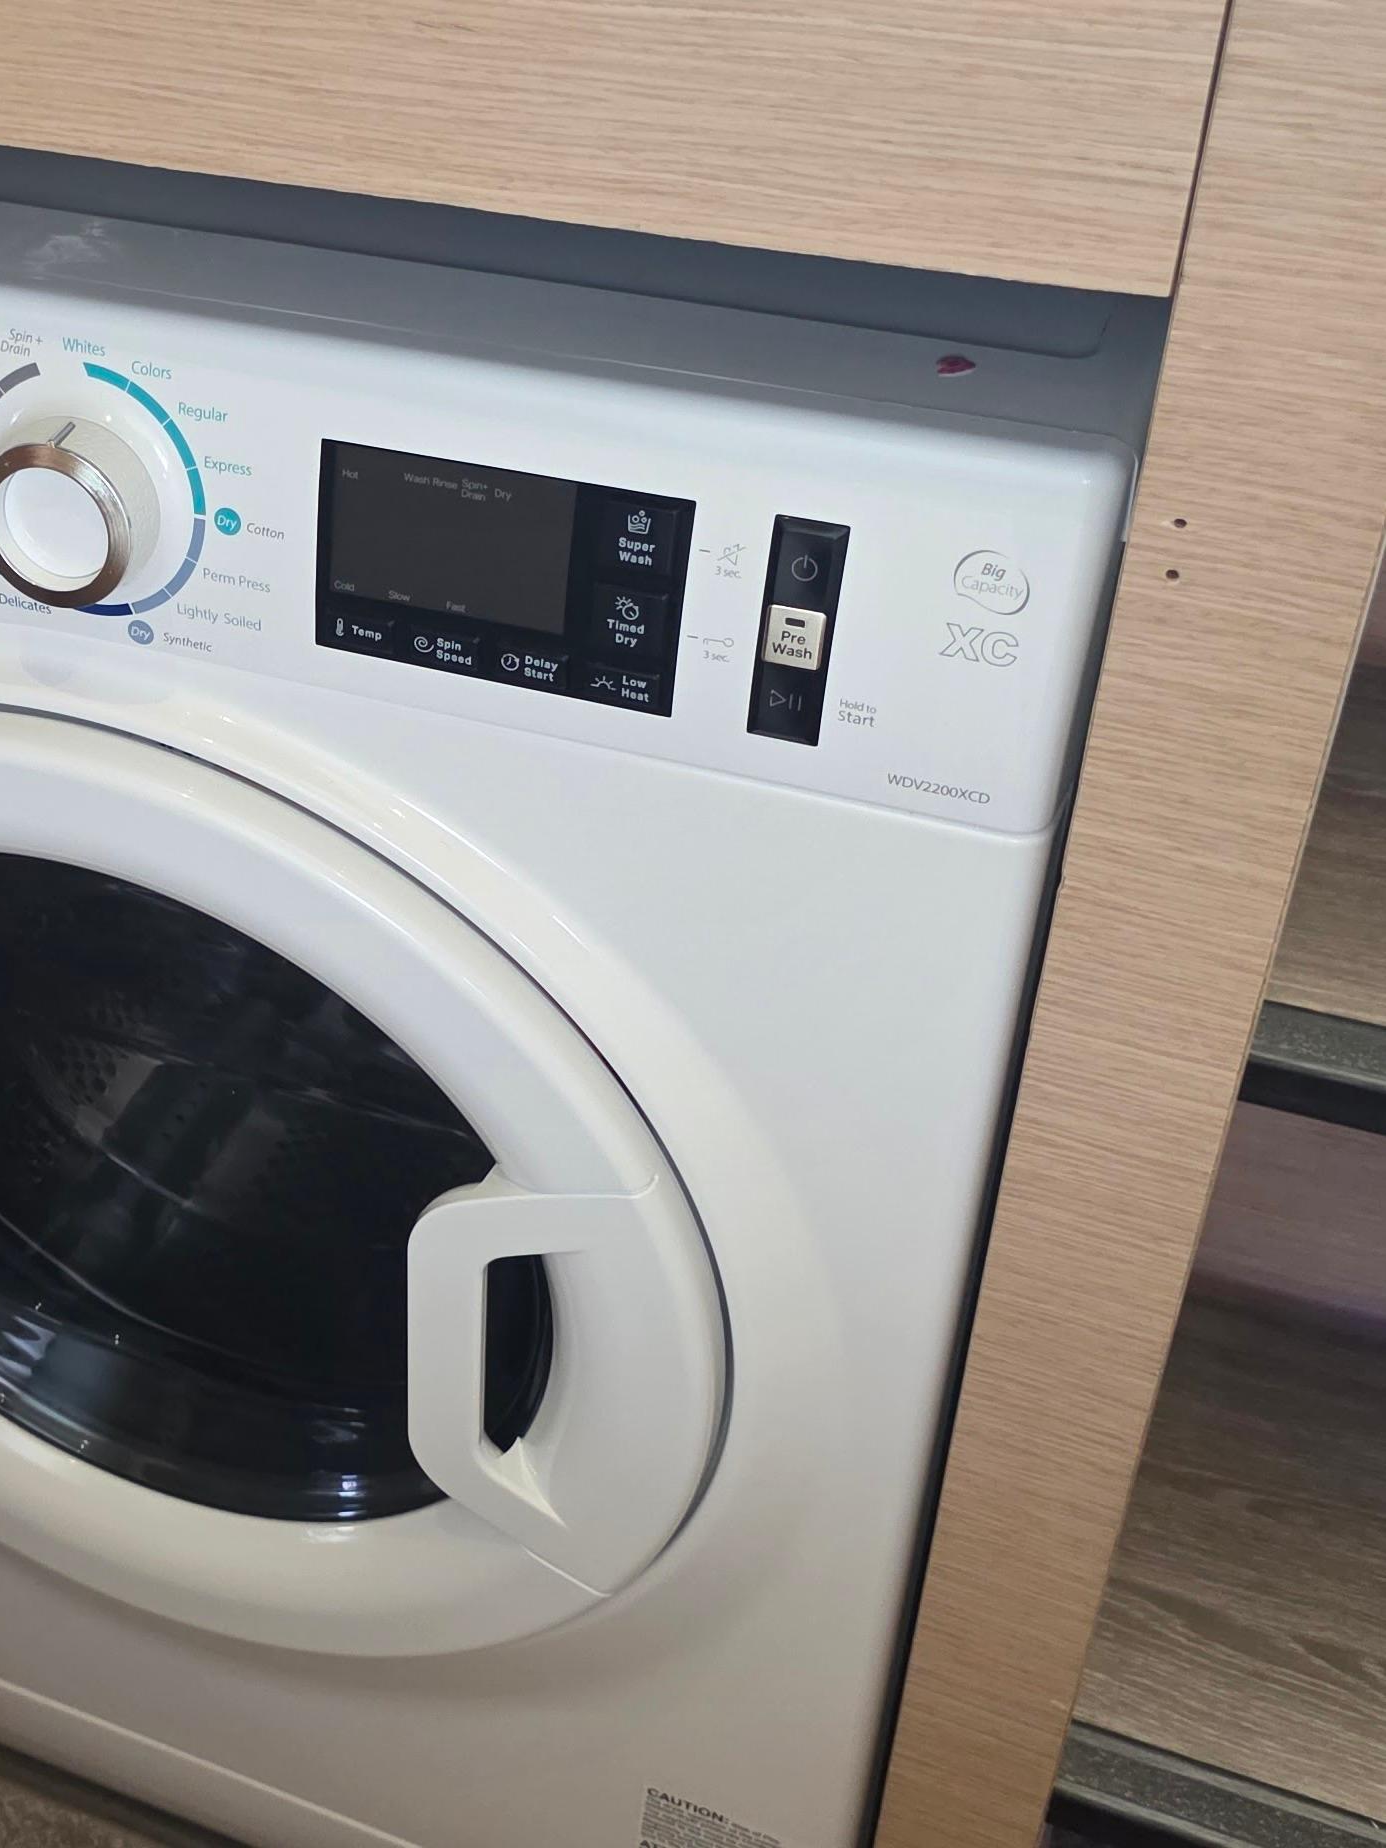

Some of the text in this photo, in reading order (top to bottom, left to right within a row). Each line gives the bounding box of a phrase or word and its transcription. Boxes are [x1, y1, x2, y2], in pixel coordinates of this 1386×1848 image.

[9, 328, 32, 346] Spin
[0, 340, 30, 357] Drain
[62, 338, 105, 357] Whites
[131, 360, 172, 380] Colors
[178, 402, 228, 423] Regular
[204, 456, 252, 477] Express
[342, 468, 358, 480] Hot
[404, 472, 430, 486] Wash
[432, 476, 458, 490] Rinse
[462, 488, 486, 502] Drain
[494, 488, 512, 502] Dry
[216, 512, 285, 541] Dry Cotton
[618, 536, 656, 556] Super
[618, 550, 652, 566] Wash
[714, 565, 722, 576] 3
[981, 562, 1007, 582] Big
[202, 568, 271, 594] Perm Press
[334, 580, 356, 592] Cold
[960, 574, 1024, 600] Capacity
[388, 589, 411, 602] Slow
[446, 600, 466, 614] Fast
[176, 603, 262, 632] Lightly Soiled
[352, 624, 382, 642] Temp
[607, 618, 645, 636] Timed
[130, 624, 212, 652] Dry Synthetic
[436, 638, 462, 654] Spin
[614, 632, 638, 648] Dry
[780, 630, 806, 646] Pre
[938, 622, 1020, 667] XC
[436, 649, 472, 667] Speed
[703, 650, 710, 660] 3
[772, 642, 812, 661] Wash
[524, 655, 559, 674] Delay
[524, 668, 554, 683] Start
[622, 676, 647, 690] Low
[621, 688, 650, 703] Heat
[840, 698, 877, 714] Hold to
[838, 709, 875, 728] Start
[887, 772, 990, 806] WDV2200XCD
